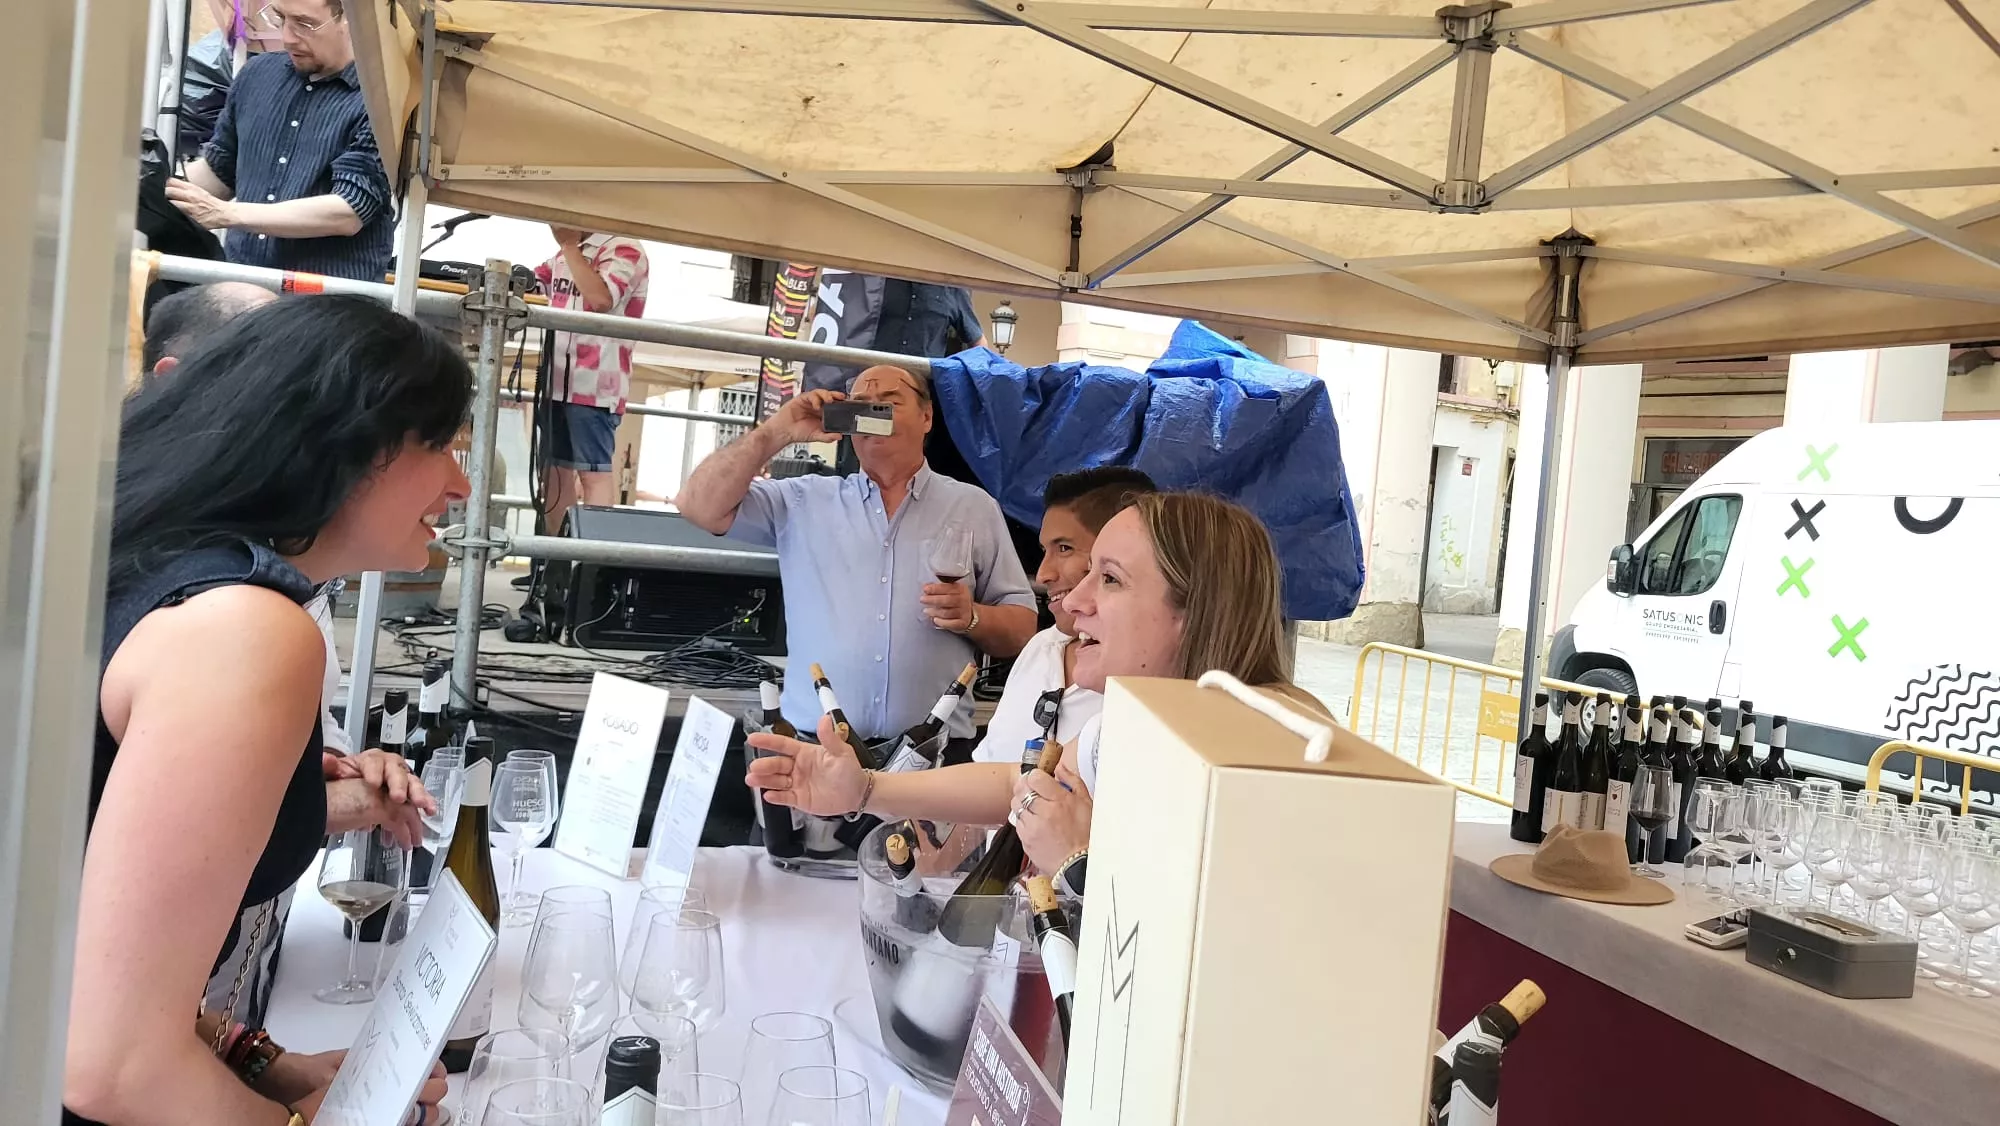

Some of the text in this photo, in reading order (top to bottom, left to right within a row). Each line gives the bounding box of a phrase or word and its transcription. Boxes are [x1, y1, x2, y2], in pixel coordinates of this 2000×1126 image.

[1642, 608, 1704, 626] SATUSONIC
[602, 711, 639, 735] ROSADO
[414, 942, 448, 1005] VICTORIA
